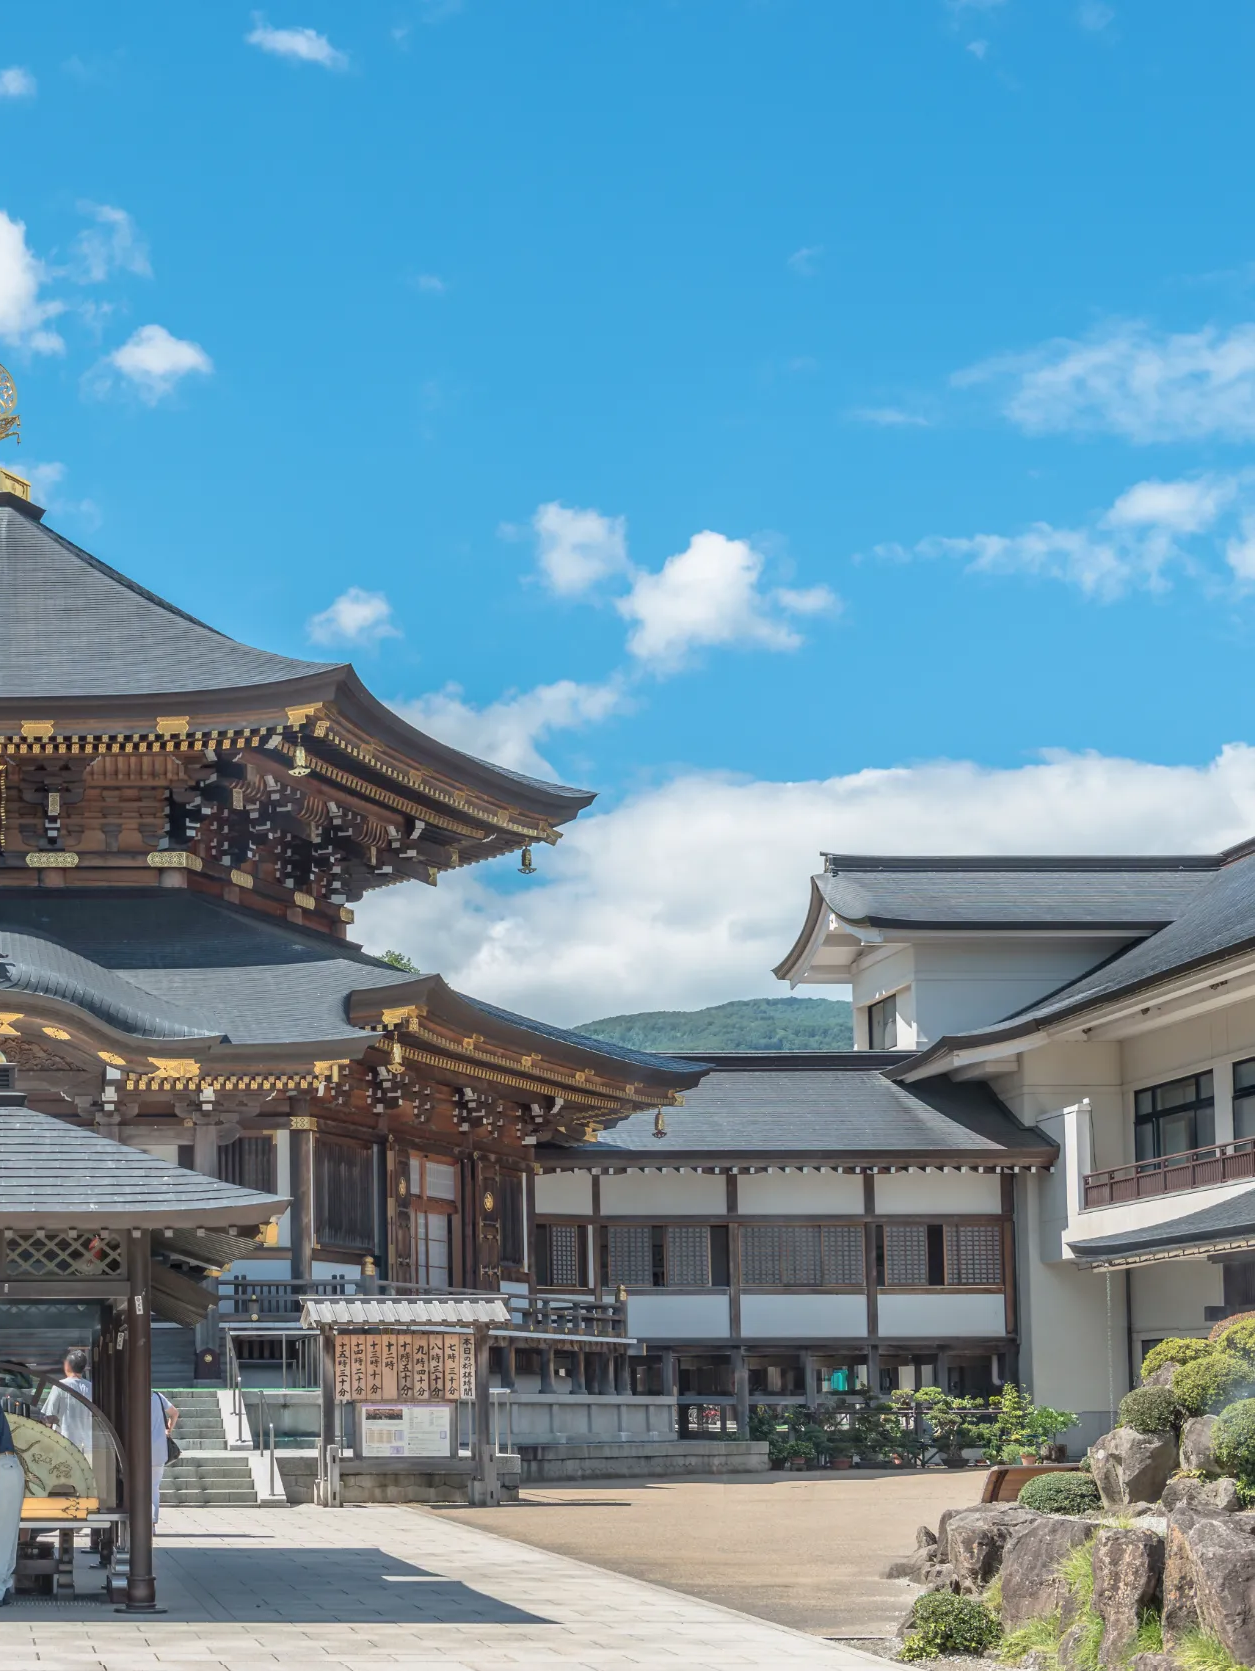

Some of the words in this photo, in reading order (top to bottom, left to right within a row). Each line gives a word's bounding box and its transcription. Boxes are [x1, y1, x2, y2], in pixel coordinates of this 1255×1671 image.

[337, 1341, 349, 1397] 十五時三十分
[353, 1341, 365, 1396] 十四時二十分
[369, 1340, 381, 1394] 十三時十分
[384, 1340, 396, 1371] 十二時
[400, 1340, 413, 1397] 十時五十分
[415, 1344, 428, 1397] 九時四十分
[431, 1343, 443, 1397] 八時三十分
[447, 1343, 458, 1396] 七時三十分
